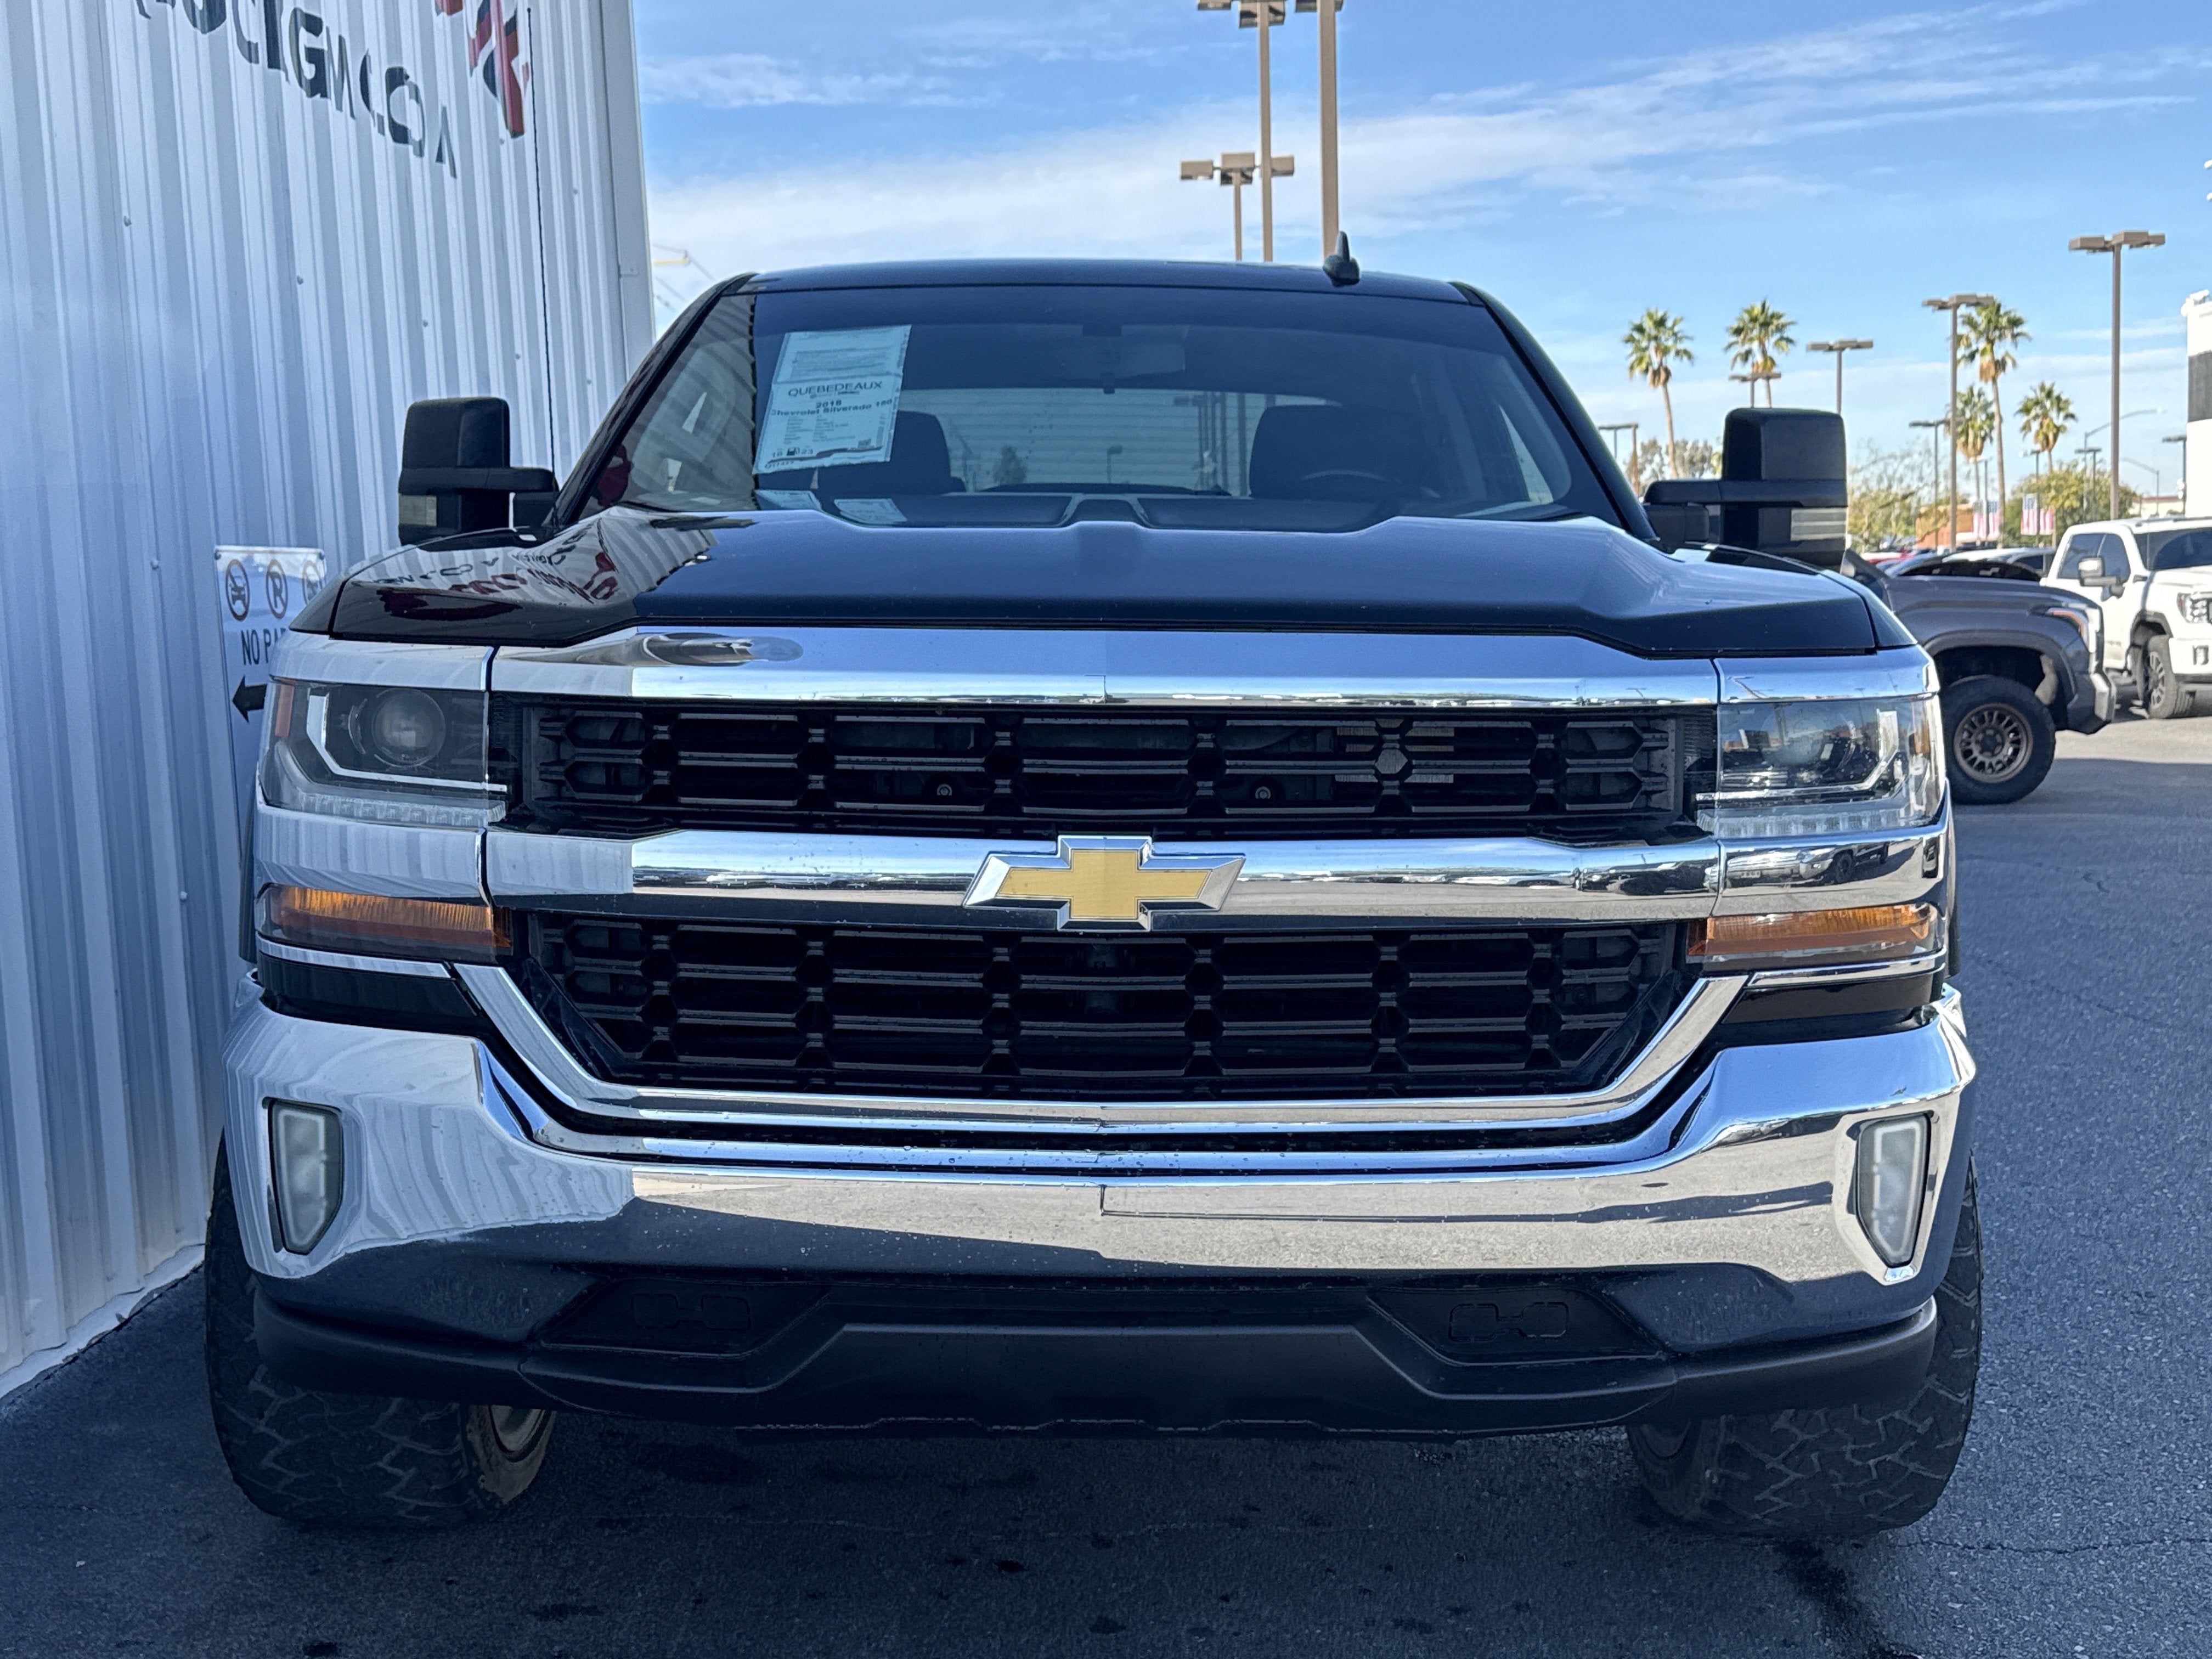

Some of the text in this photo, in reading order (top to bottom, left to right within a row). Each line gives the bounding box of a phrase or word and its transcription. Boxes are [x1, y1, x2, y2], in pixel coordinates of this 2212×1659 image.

[788, 381, 883, 397] QUEBEDEAUX
[823, 404, 872, 414] Silverado
[240, 629, 260, 665] NO
